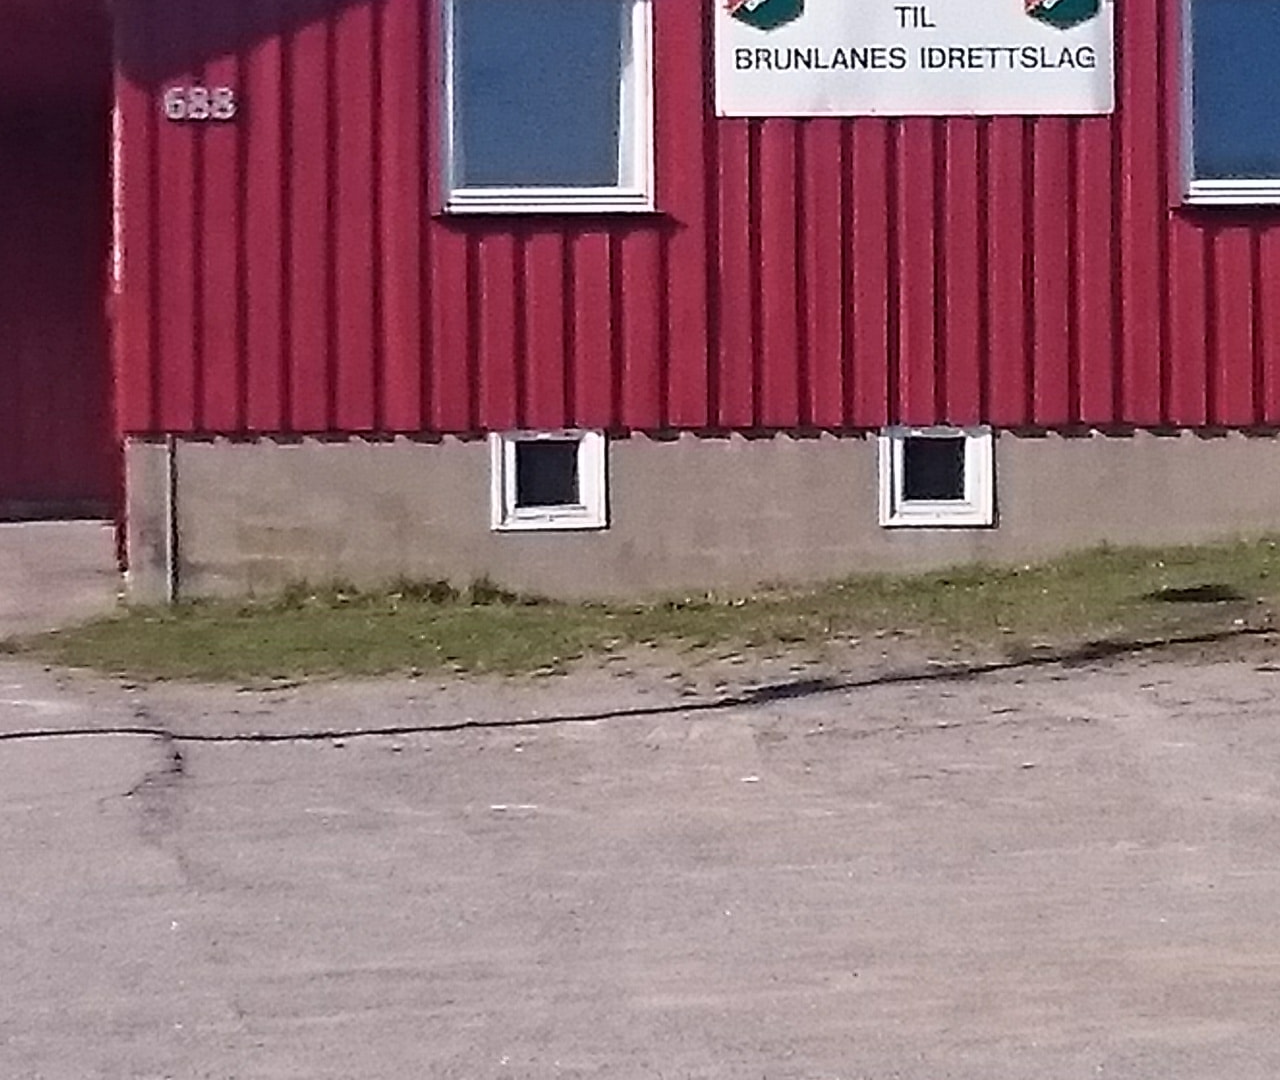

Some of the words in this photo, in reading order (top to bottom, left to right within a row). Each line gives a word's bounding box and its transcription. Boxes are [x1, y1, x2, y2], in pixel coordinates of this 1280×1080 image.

[893, 5, 936, 29] TIL
[734, 46, 907, 71] BRUNLANES
[919, 45, 1096, 70] IDRETTSLAG
